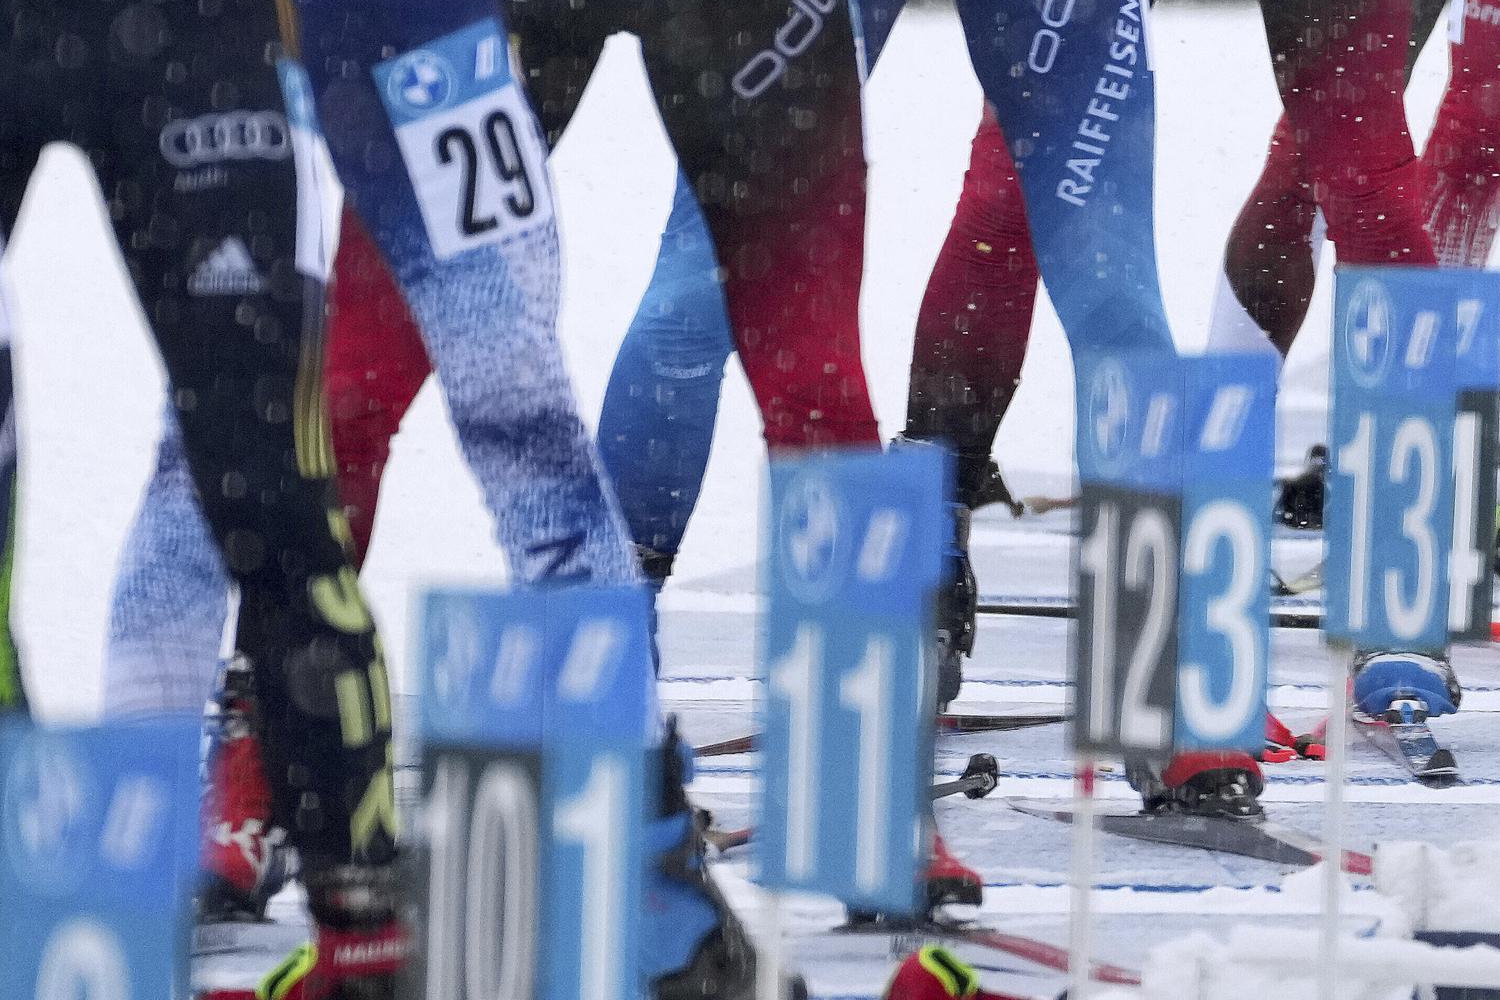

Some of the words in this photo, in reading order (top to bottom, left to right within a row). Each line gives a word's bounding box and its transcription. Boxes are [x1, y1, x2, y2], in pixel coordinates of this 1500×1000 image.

[434, 109, 536, 238] 29
[1079, 504, 1177, 749] 12
[1335, 411, 1440, 641] 13
[412, 754, 542, 1000] 10
[769, 619, 895, 893] 11
